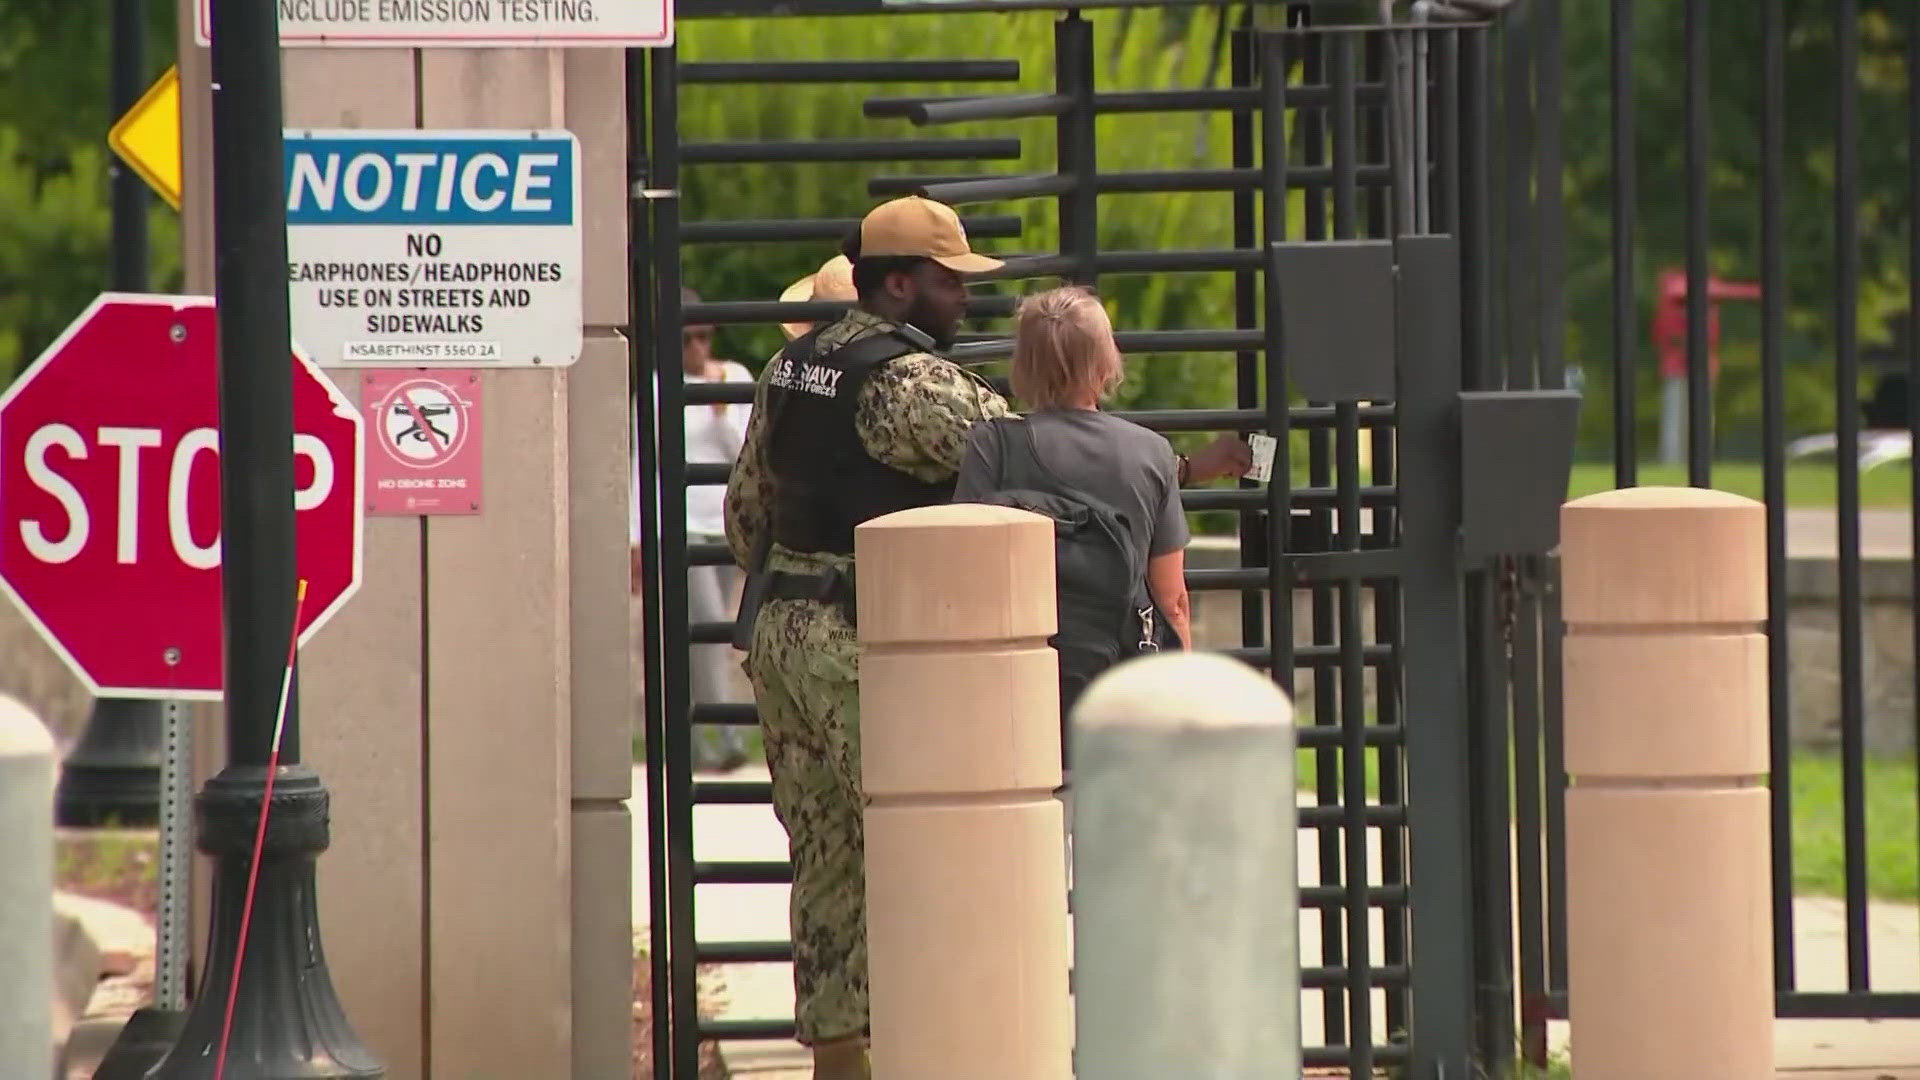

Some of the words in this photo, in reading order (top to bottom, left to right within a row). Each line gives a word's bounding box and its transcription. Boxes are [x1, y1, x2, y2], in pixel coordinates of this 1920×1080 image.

[279, 0, 371, 22] NCLUDE
[378, 0, 490, 22] EMISSION
[499, 0, 600, 22] TESTING.
[286, 152, 559, 213] NOTICE
[406, 233, 443, 257] NO
[319, 288, 360, 308] USE
[364, 288, 392, 308] ON
[397, 288, 484, 308] STREETS
[488, 288, 531, 308] AND
[366, 314, 484, 334] SIDEWALKS
[19, 423, 335, 570] STOP
